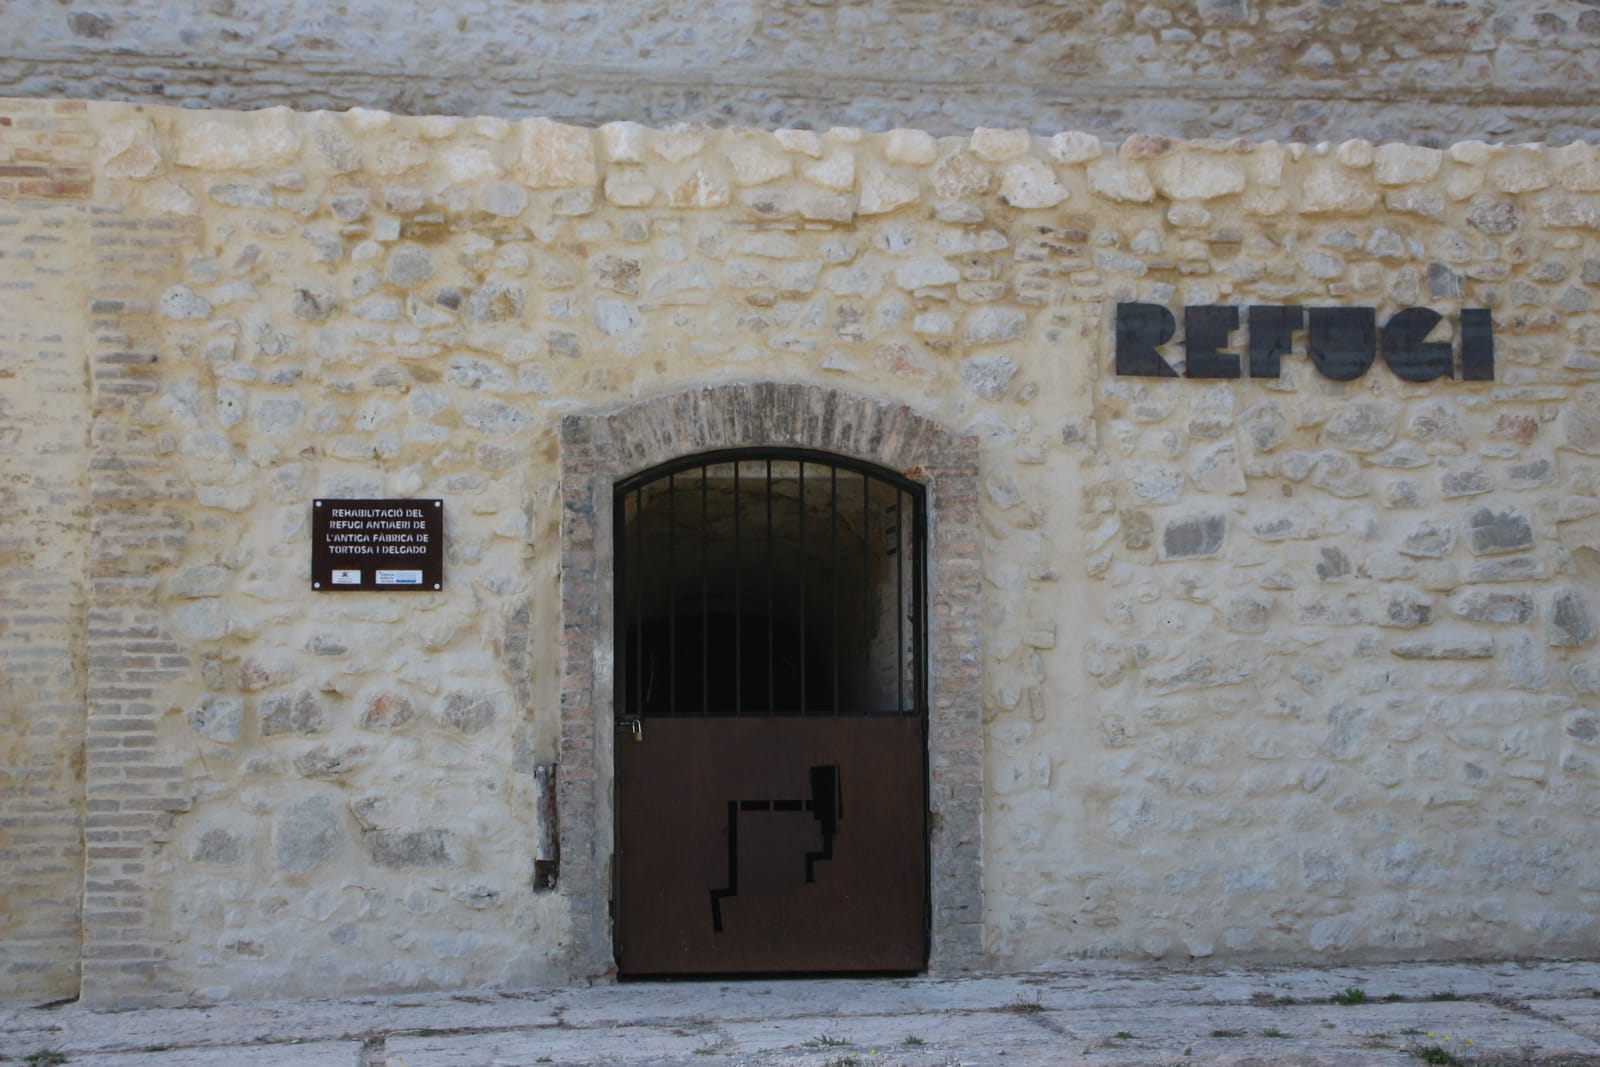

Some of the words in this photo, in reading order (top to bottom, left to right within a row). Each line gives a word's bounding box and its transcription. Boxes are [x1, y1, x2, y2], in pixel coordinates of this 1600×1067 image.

[1116, 302, 1495, 382] REFUGI
[406, 509, 423, 518] DEL
[330, 521, 363, 529] REFUGI
[366, 521, 410, 529] ANTIAERI
[413, 521, 426, 529] DE
[326, 534, 370, 542] L'ANTIGA
[416, 534, 429, 542] DE
[328, 545, 374, 554] TORTOSA
[382, 546, 427, 554] DELGADO
